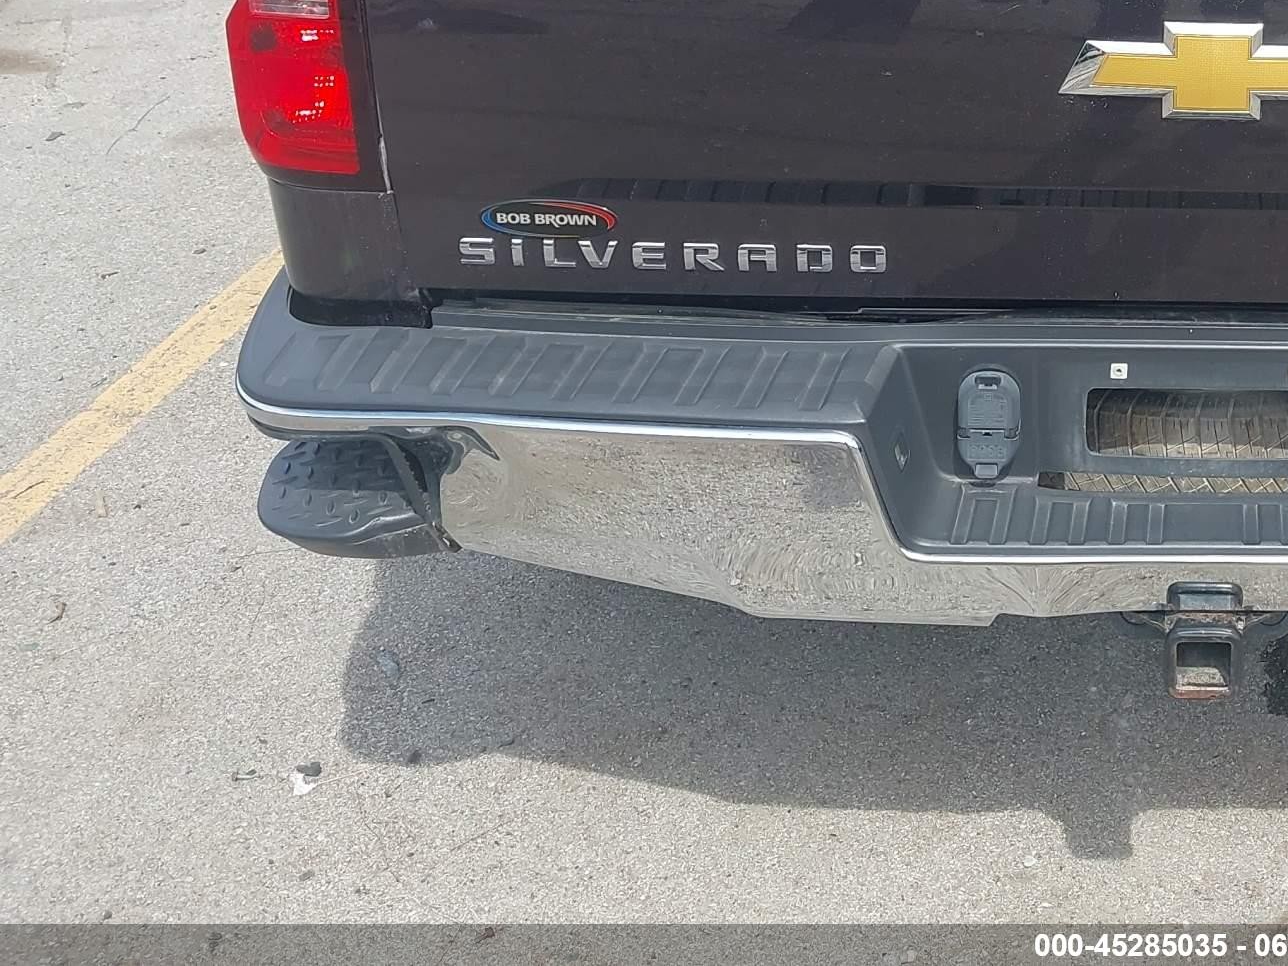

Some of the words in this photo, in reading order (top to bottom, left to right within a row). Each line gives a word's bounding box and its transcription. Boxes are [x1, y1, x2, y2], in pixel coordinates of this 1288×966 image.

[496, 212, 531, 225] BOB
[534, 213, 597, 228] BROWN
[459, 237, 888, 273] SILVERADO
